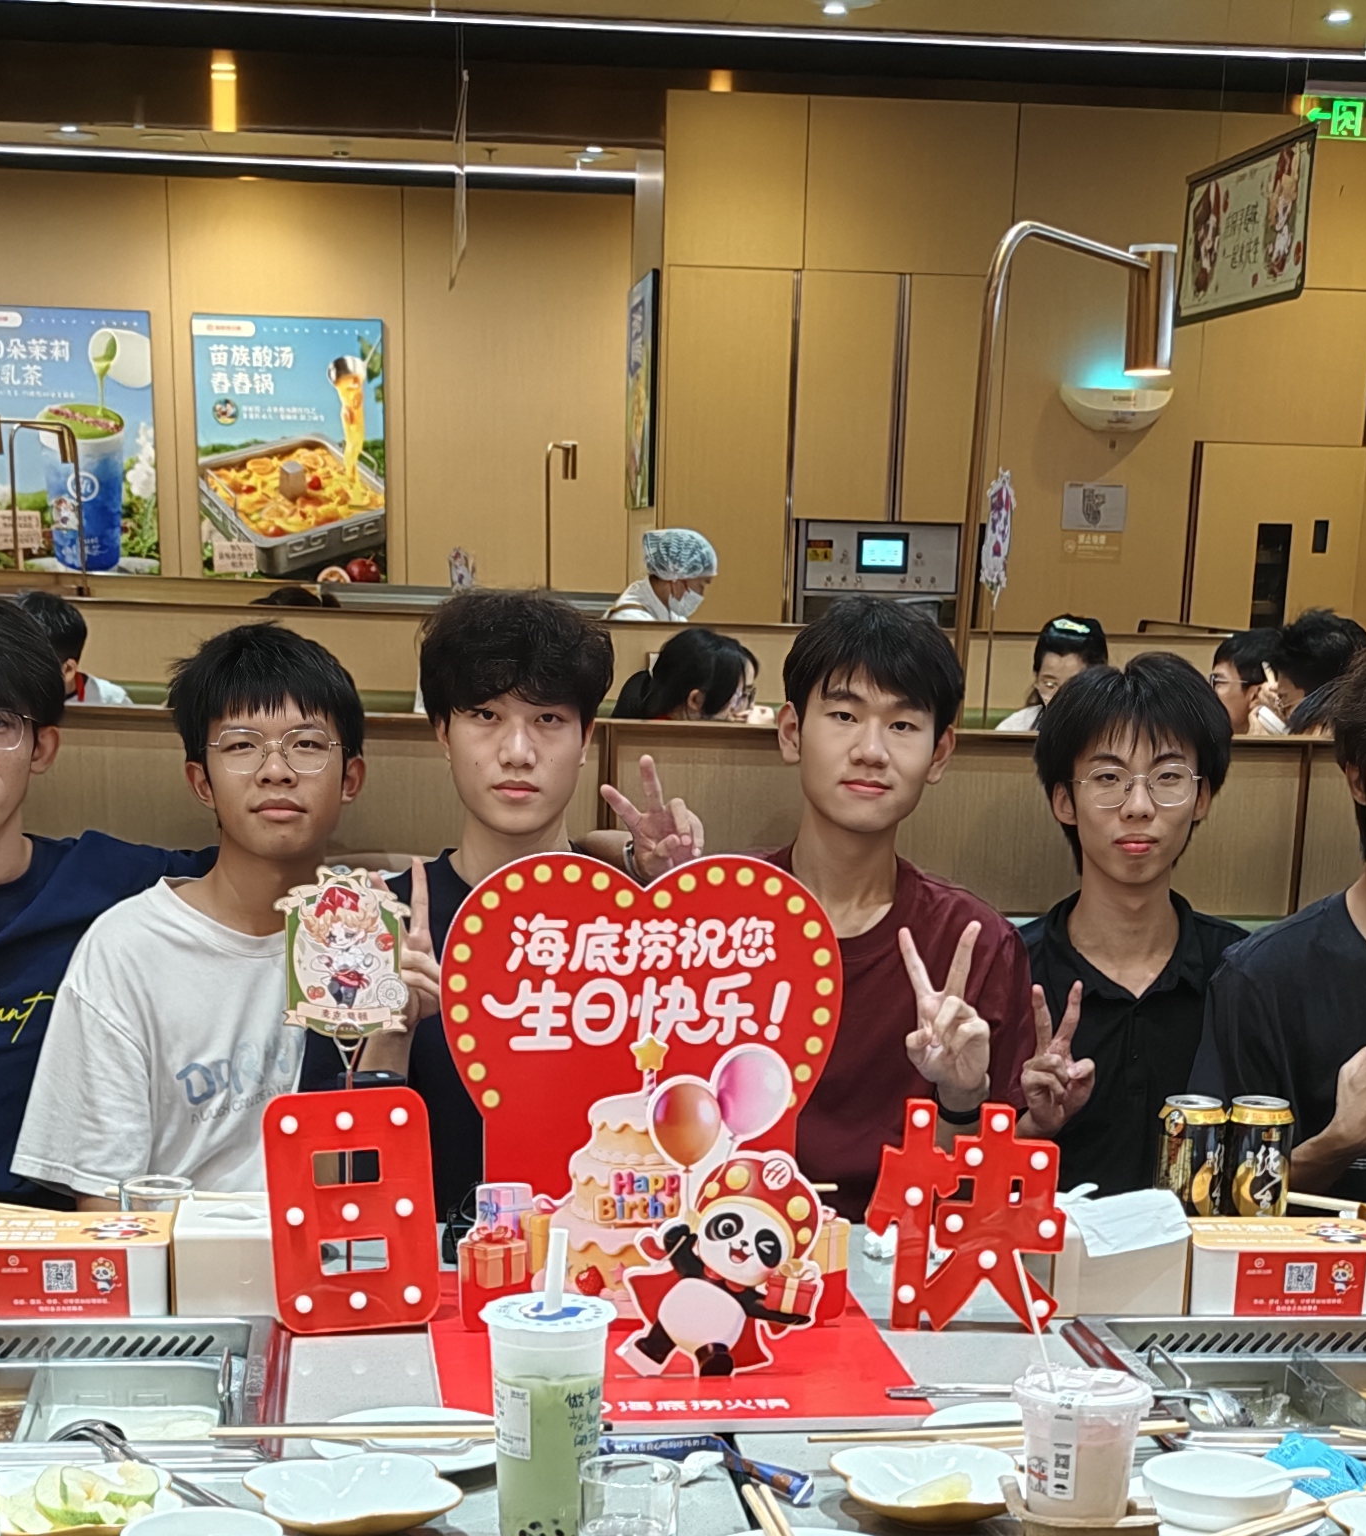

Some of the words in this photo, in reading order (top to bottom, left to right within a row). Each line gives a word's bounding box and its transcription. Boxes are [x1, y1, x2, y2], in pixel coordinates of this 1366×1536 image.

[208, 344, 295, 369] 苗族酸汤
[505, 912, 777, 976] 海底捞祝您
[481, 971, 792, 1051] 生日快乐!
[613, 1172, 681, 1197] Happ
[262, 1086, 441, 1333] 日
[597, 1194, 681, 1221] Birthd
[867, 1097, 1068, 1332] 快
[617, 1398, 791, 1412] 海底捞火锅
